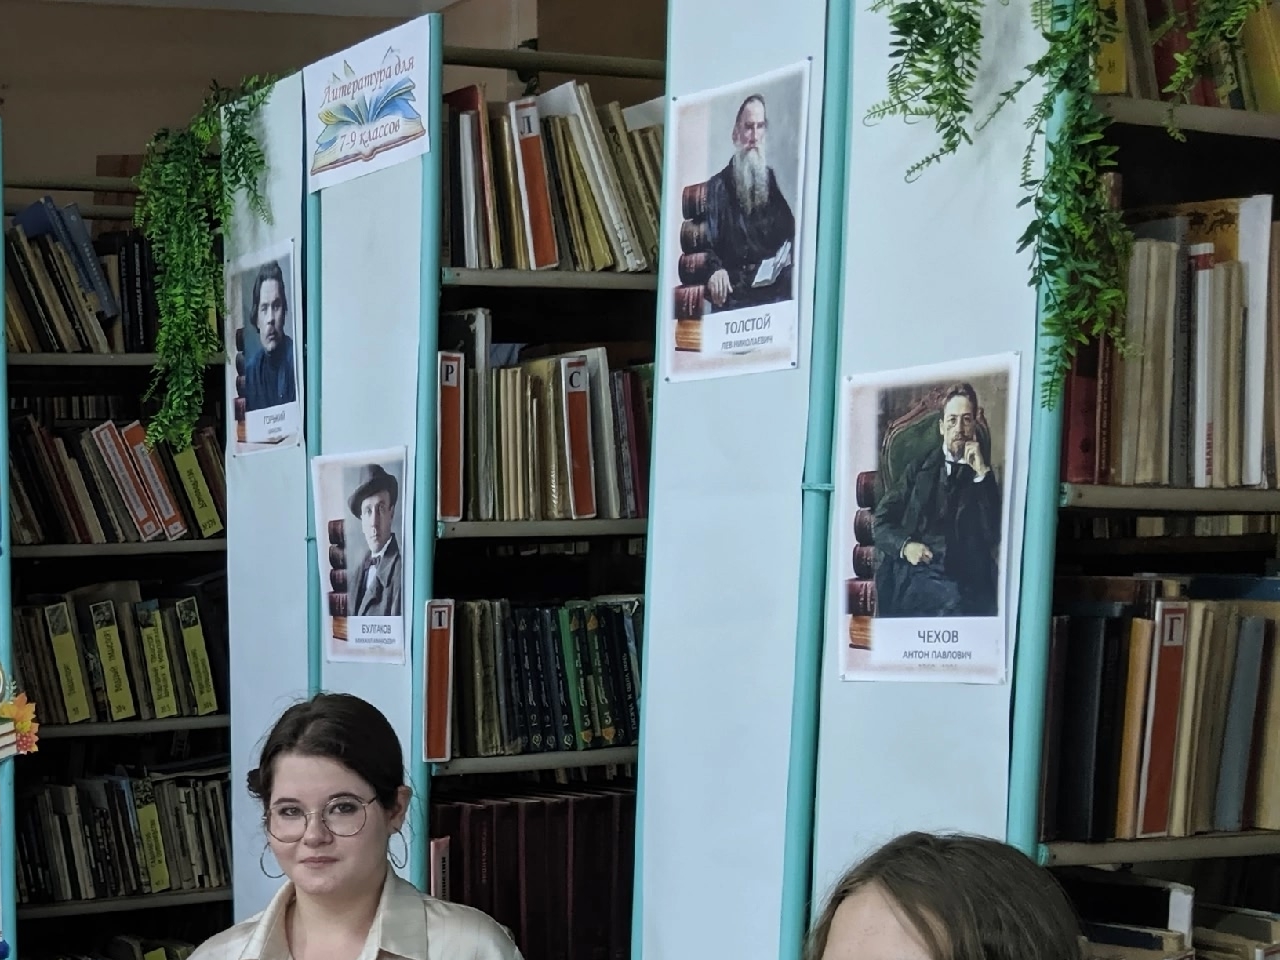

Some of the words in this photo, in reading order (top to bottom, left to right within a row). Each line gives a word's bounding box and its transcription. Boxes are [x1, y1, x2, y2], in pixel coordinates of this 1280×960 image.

[320, 65, 393, 109] Литература
[394, 55, 415, 77] для
[339, 133, 357, 152] 7-9
[360, 118, 401, 148] классов
[724, 313, 771, 335] ТОЛСТОЙ
[722, 341, 732, 350] ЛЕВ
[733, 335, 773, 349] НИКОЛАЕВИЧ
[444, 364, 455, 382] Р
[569, 371, 581, 389] С
[435, 610, 446, 627] Т
[361, 624, 391, 634] БУЛГАКОВ
[918, 630, 959, 643] ЧЕХОВ
[1166, 616, 1181, 645] Г
[903, 651, 930, 660] АНТОН
[932, 651, 972, 660] ПАВЛОВИЧ
